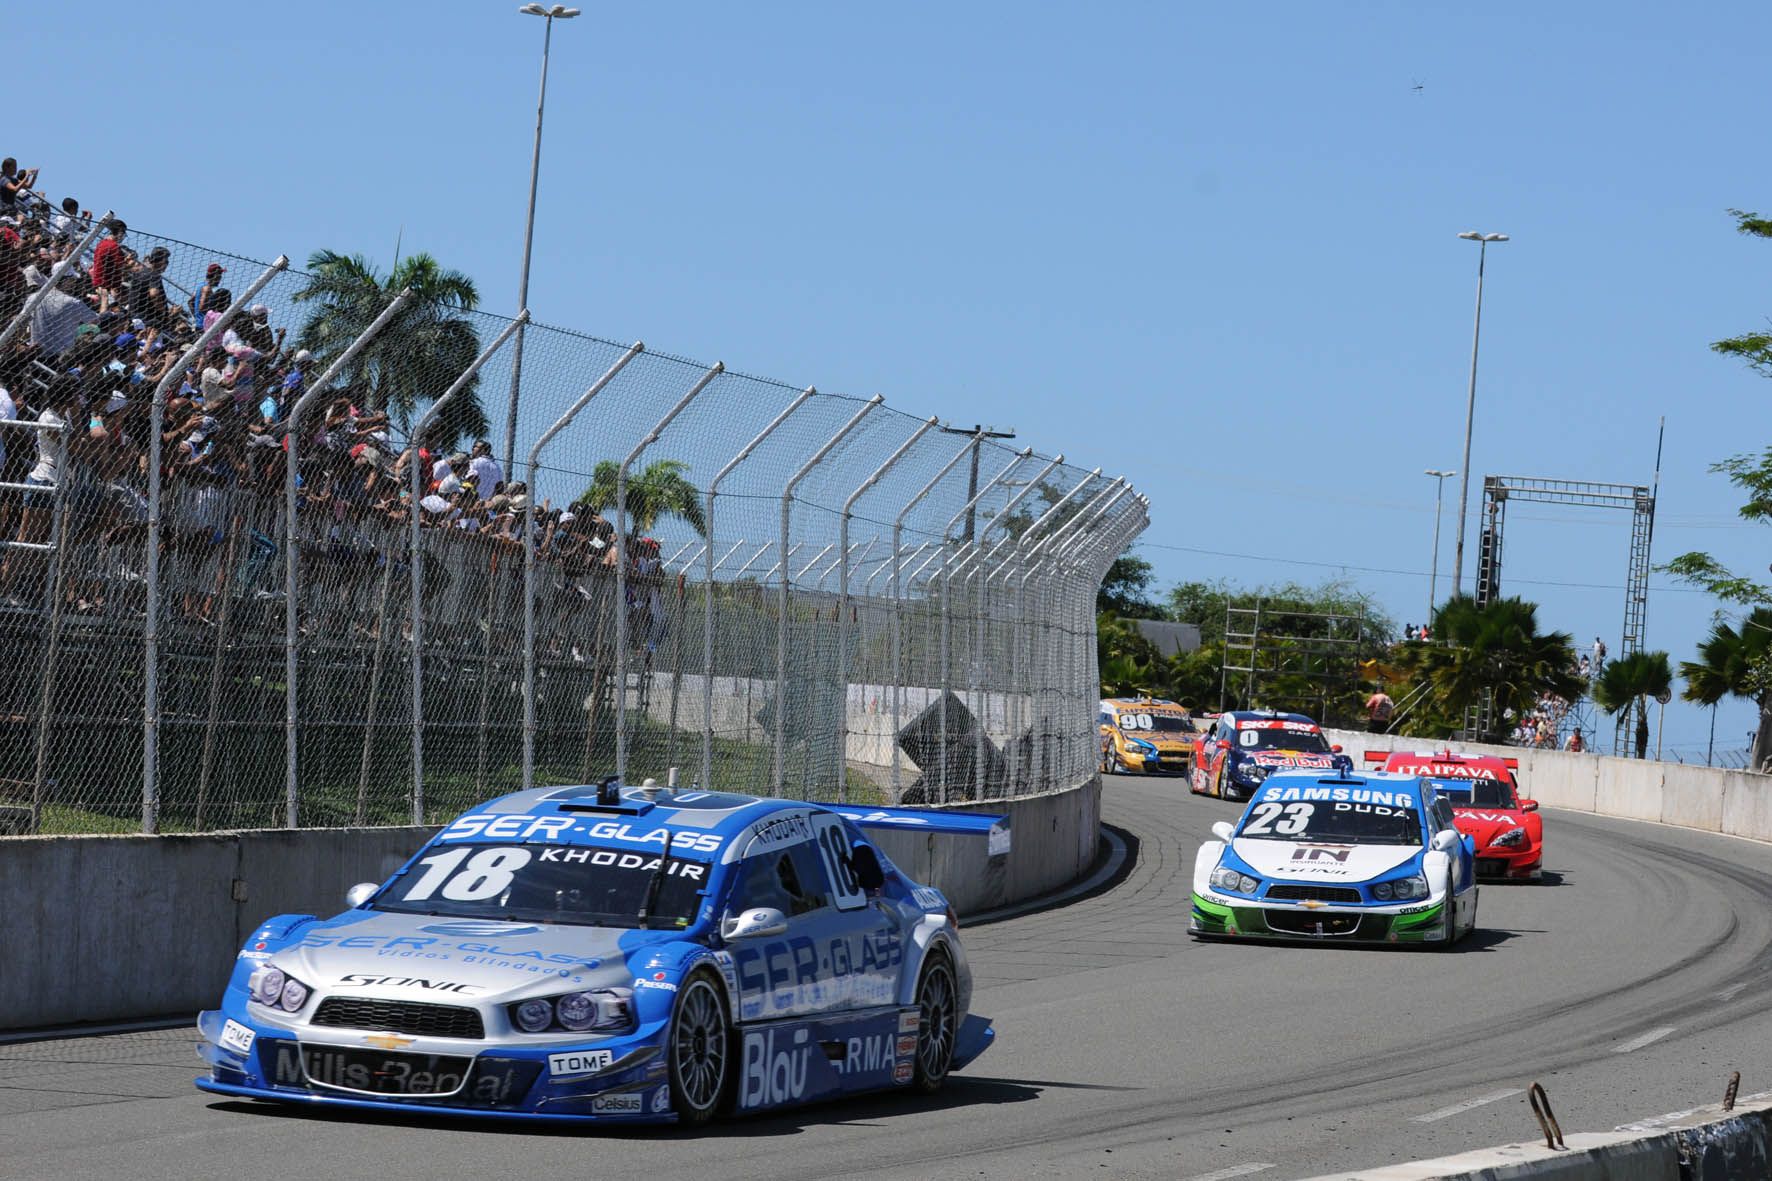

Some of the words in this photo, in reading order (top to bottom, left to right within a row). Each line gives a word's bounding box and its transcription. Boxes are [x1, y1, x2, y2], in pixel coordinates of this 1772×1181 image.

[1120, 713, 1154, 730] 90
[1241, 720, 1272, 729] SKY
[1282, 721, 1314, 732] SKY
[1239, 730, 1259, 747] 0
[1255, 755, 1295, 766] Red
[1296, 757, 1333, 768] Bull
[1398, 765, 1496, 780] ITAIPAVA
[1263, 787, 1412, 807] SAMSUNG
[1242, 802, 1315, 835] 23
[1335, 802, 1410, 819] DUDA
[539, 848, 705, 880] KHODAIR
[819, 825, 860, 898] 18
[402, 846, 533, 901] 18
[377, 949, 450, 960] Vidros
[463, 955, 582, 983] Blindados
[332, 974, 486, 996] SONIC
[275, 1047, 369, 1087] Mills
[594, 1096, 641, 1110] Celsius
